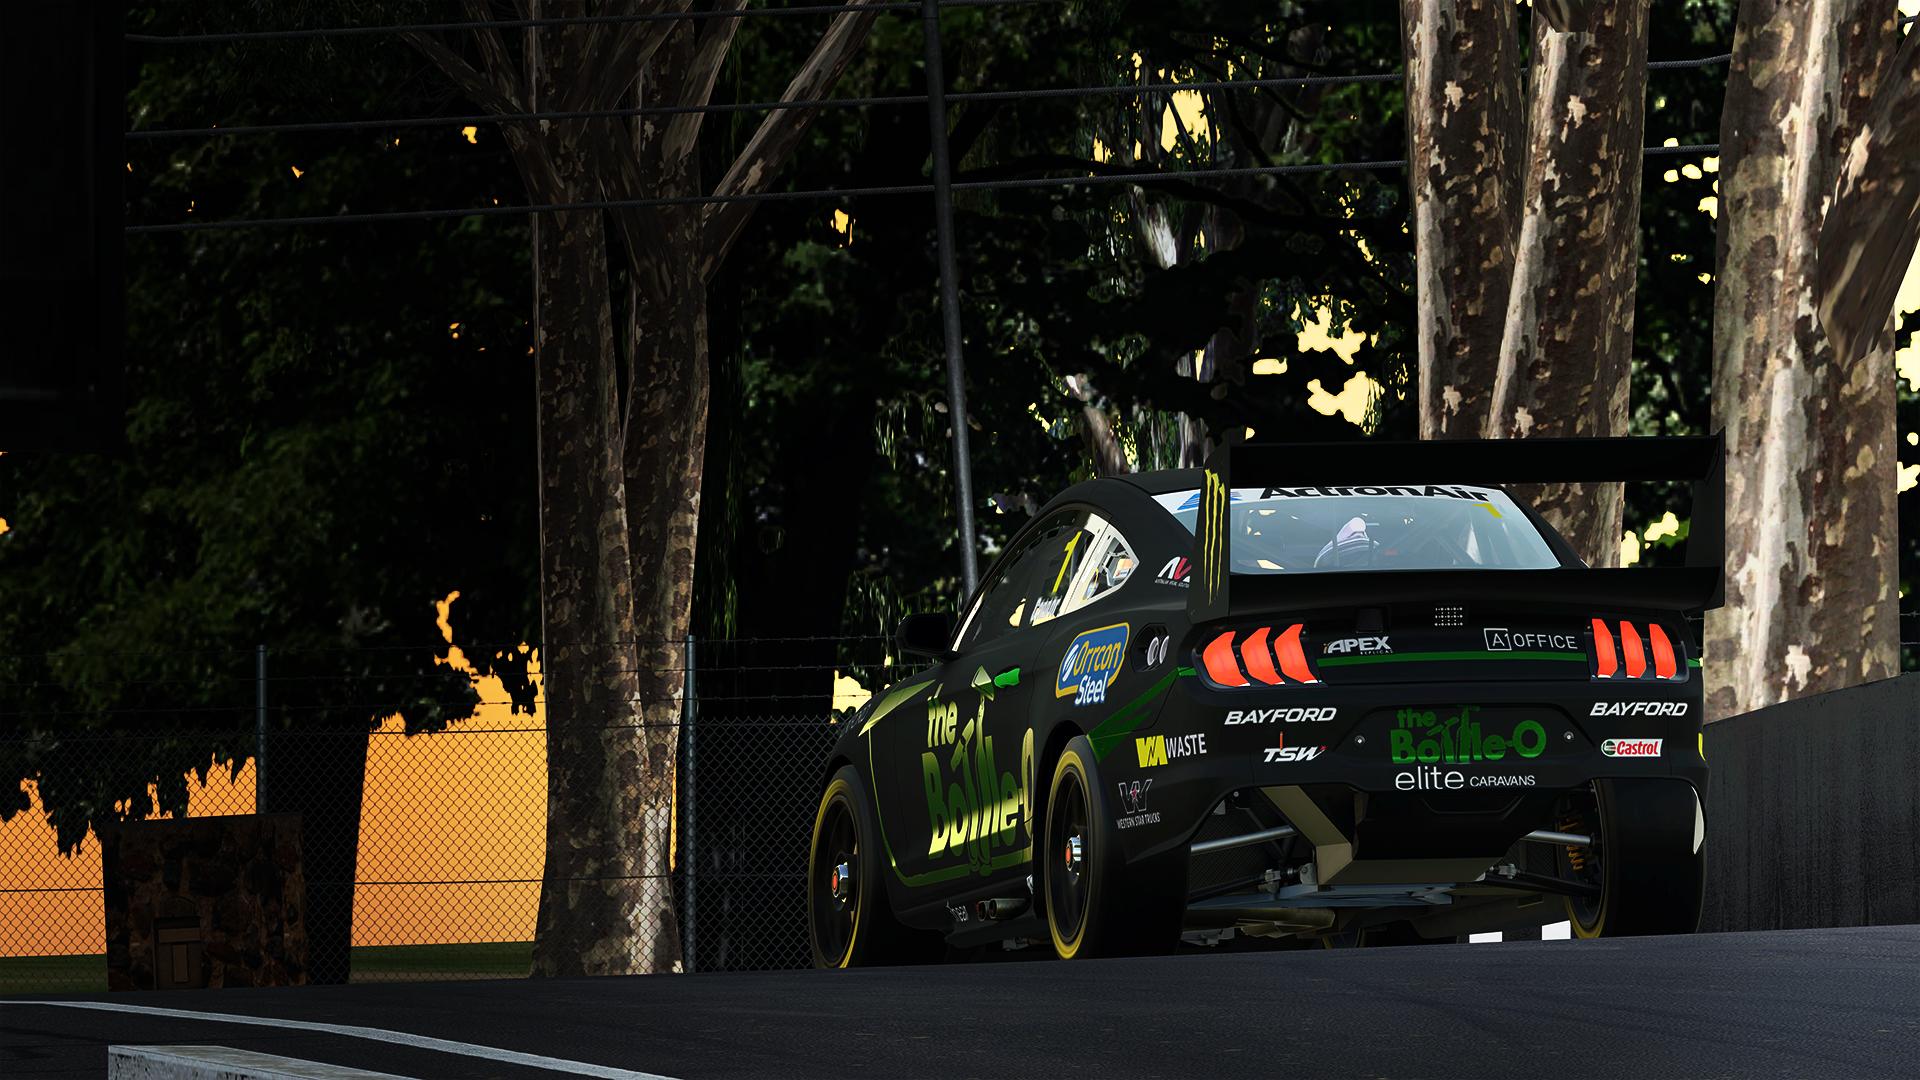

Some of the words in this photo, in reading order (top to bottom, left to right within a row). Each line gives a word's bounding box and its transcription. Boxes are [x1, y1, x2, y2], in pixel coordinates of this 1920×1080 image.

[1260, 485, 1489, 502] ActronAir
[1052, 530, 1083, 593] 1
[1513, 633, 1578, 649] OFFICE
[1073, 640, 1121, 676] Orrcon
[1075, 671, 1108, 706] Steel
[1224, 707, 1337, 725] BAYFORD
[1397, 708, 1436, 728] the
[1590, 702, 1688, 716] BAYFORD
[1166, 733, 1207, 759] WASTE
[1264, 746, 1328, 762] TSW
[1616, 741, 1659, 755] Castrol
[1395, 766, 1464, 791] elite
[1470, 775, 1536, 787] CARAVANS
